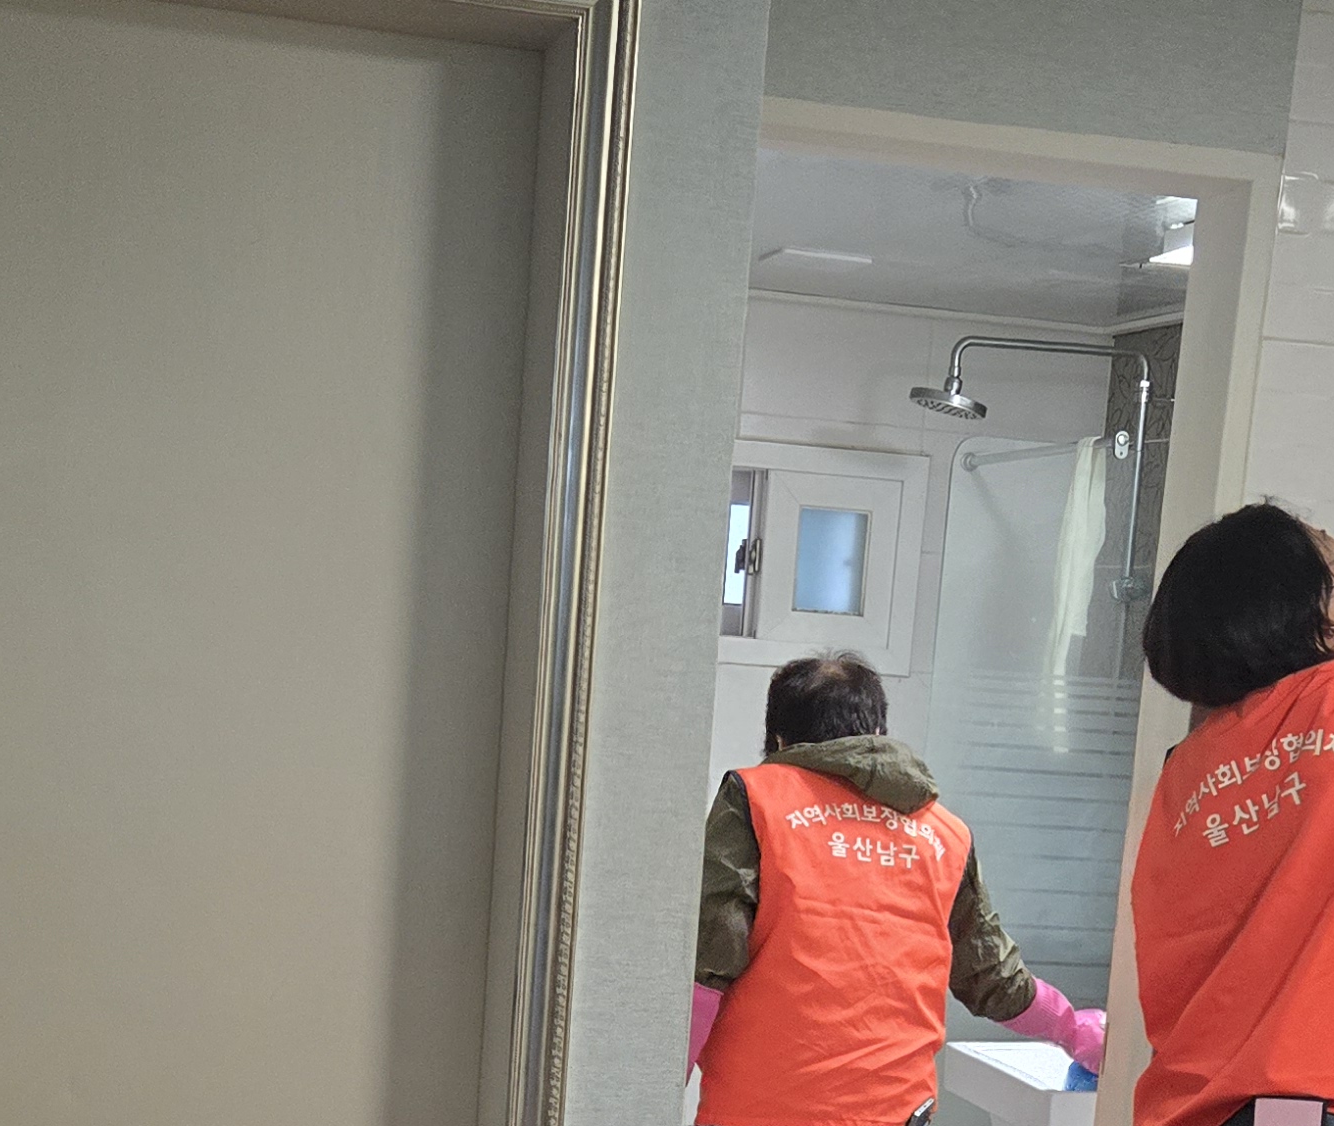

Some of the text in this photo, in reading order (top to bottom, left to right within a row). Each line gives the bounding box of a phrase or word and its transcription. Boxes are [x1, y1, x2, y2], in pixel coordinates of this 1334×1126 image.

[785, 802, 946, 861] 지역사회보장협의체
[1202, 771, 1307, 848] 울산남구
[828, 832, 920, 869] 울산남구
